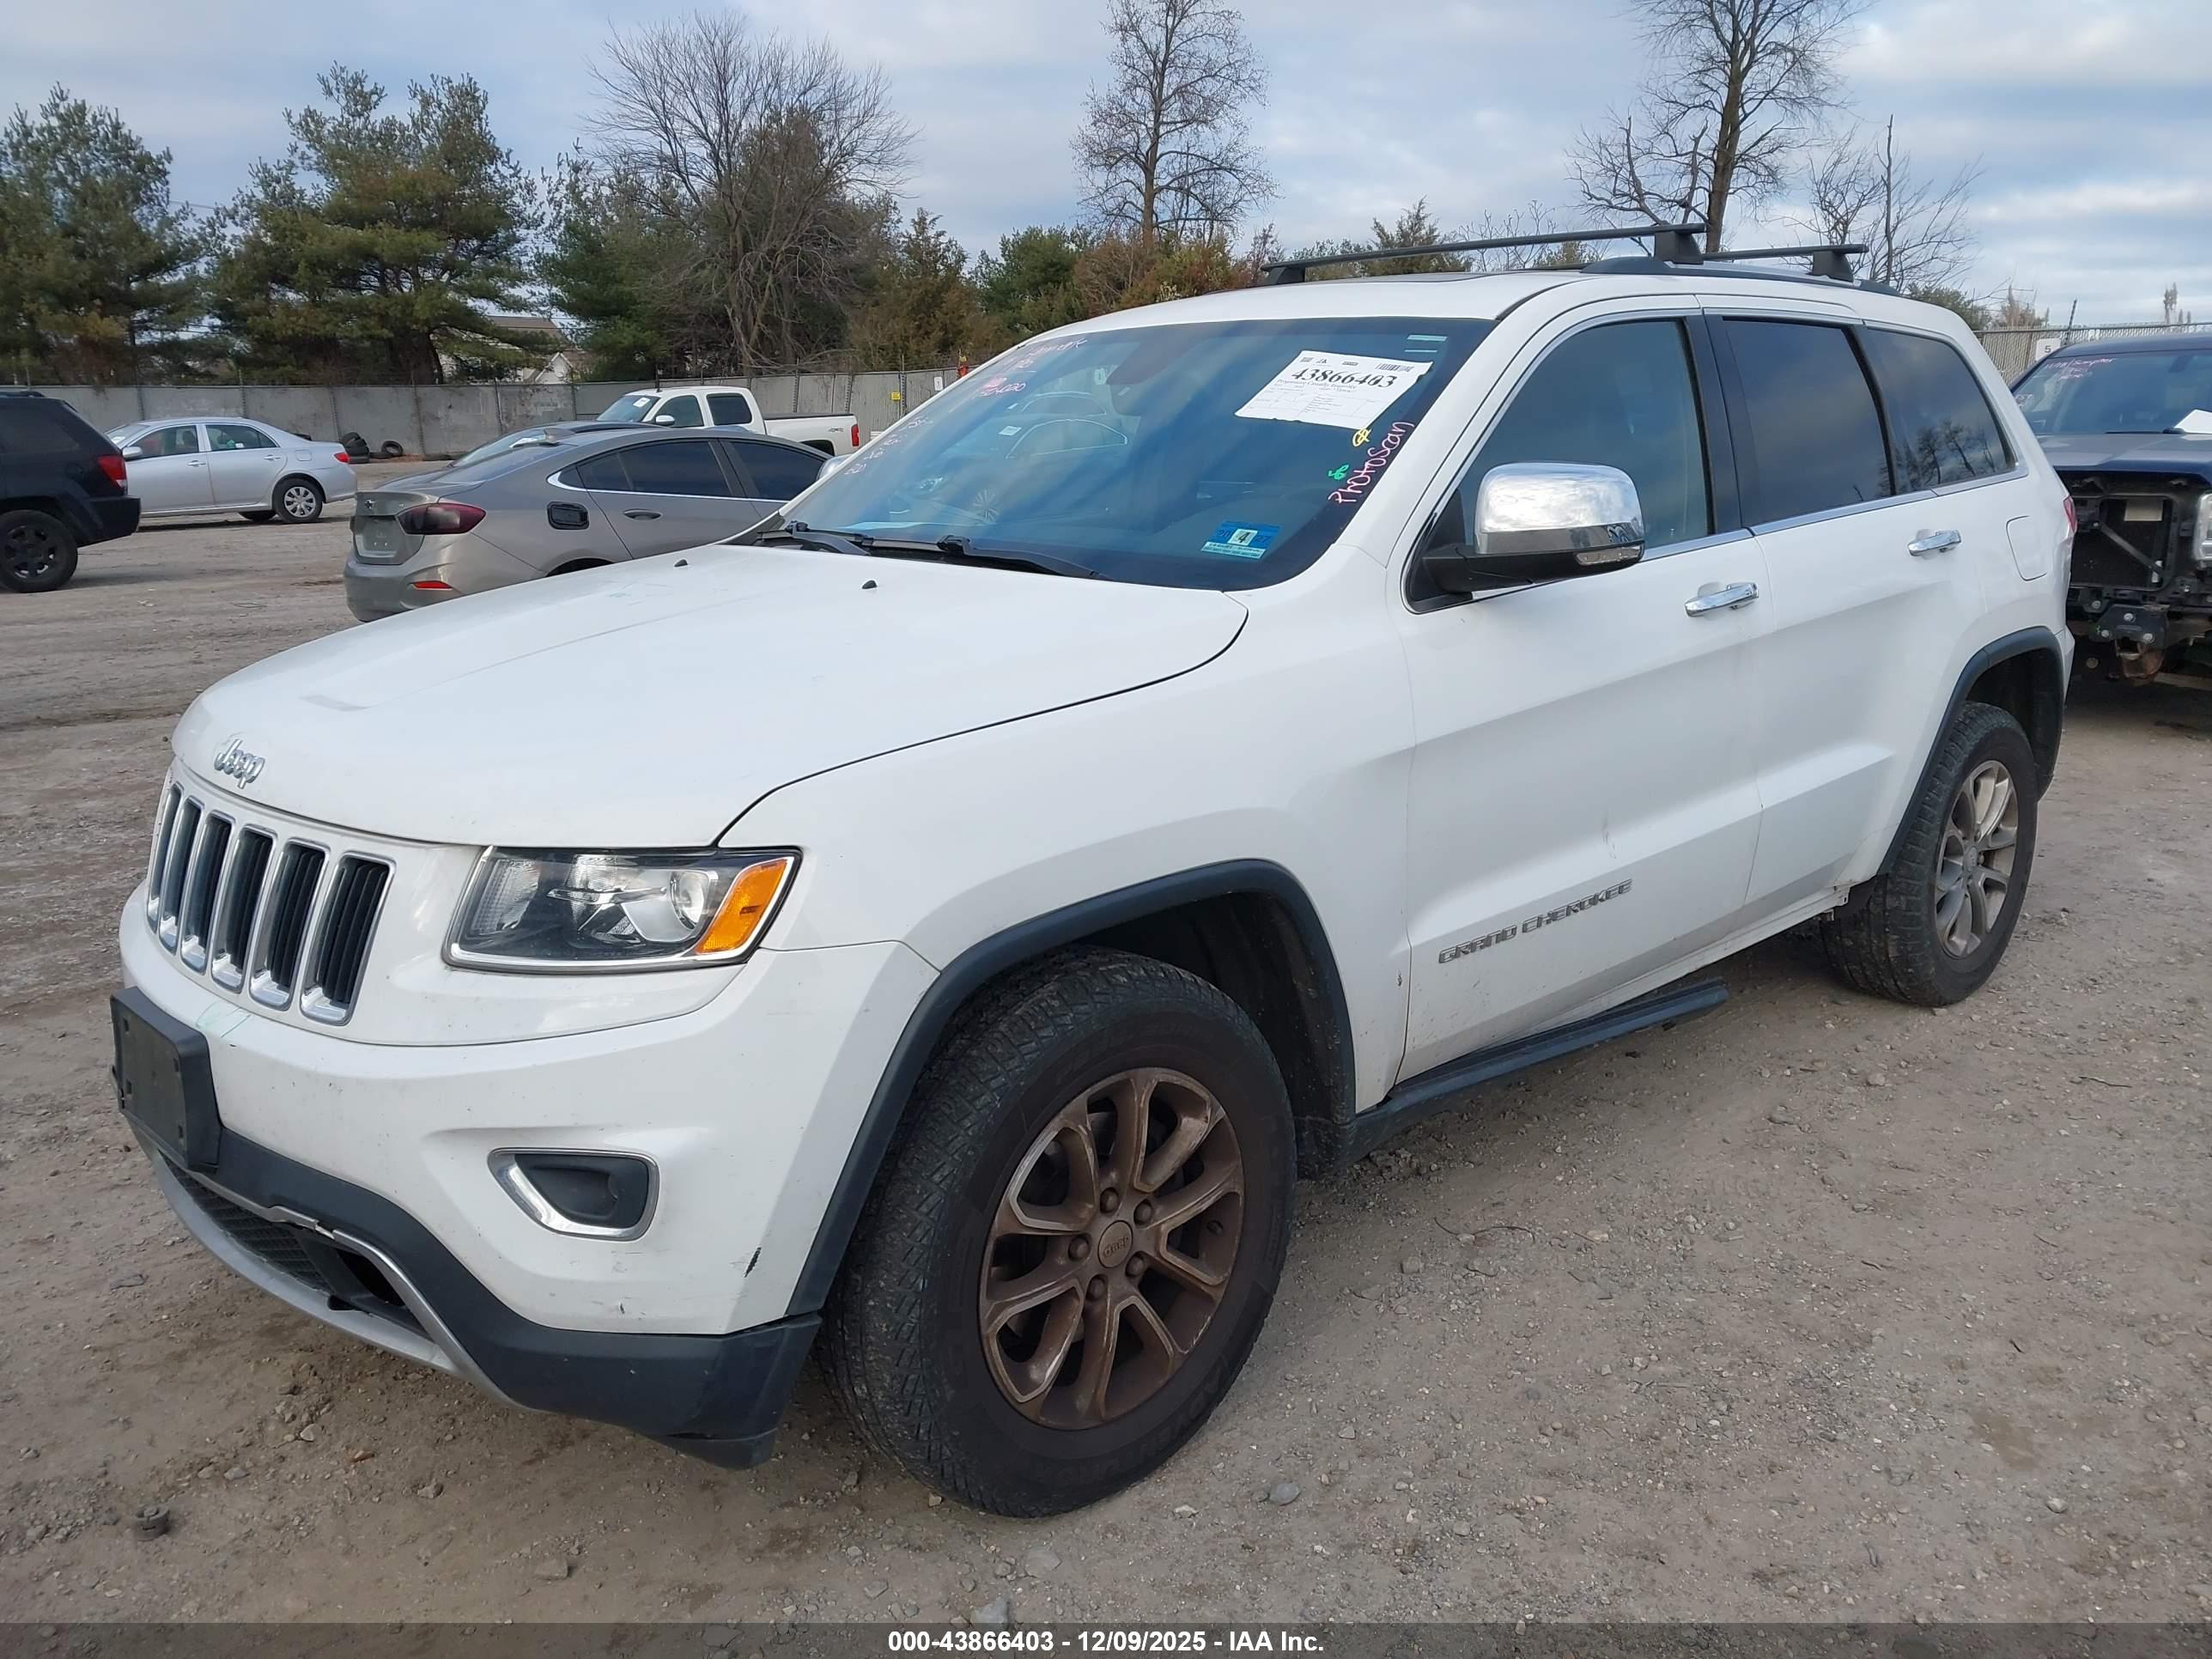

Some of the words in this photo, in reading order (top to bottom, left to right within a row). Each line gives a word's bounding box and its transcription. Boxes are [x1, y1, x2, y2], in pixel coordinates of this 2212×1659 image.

[2044, 344, 2052, 354] 5
[1291, 367, 1398, 388] 43866403
[1237, 532, 1251, 544] 4
[213, 738, 265, 789] Jeep
[1437, 924, 1518, 964] GRAND
[1521, 878, 1633, 934] CHEROKEE
